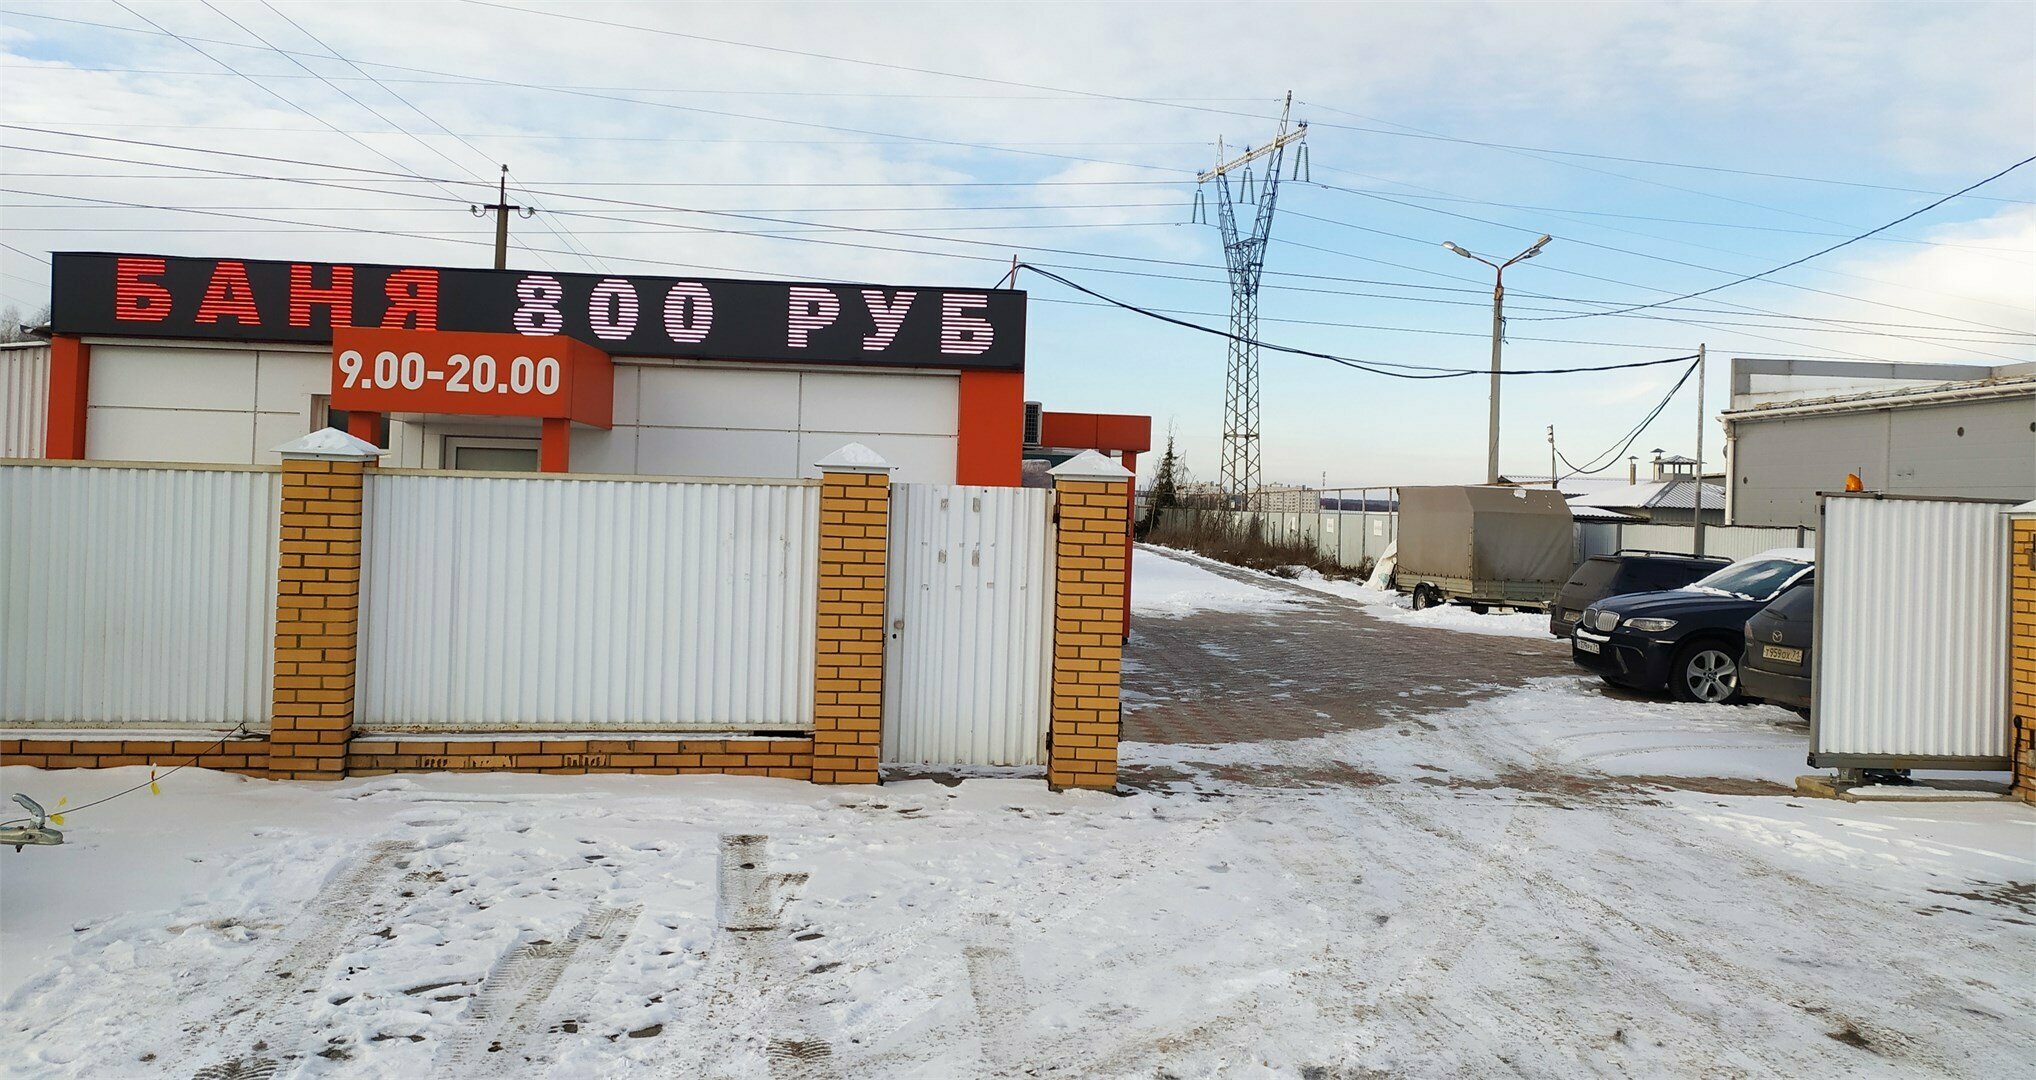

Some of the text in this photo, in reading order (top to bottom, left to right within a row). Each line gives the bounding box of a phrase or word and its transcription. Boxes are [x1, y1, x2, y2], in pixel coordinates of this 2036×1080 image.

[115, 257, 995, 354] БАНЯ 800 РУБ
[338, 350, 561, 395] 9.00-20.00
